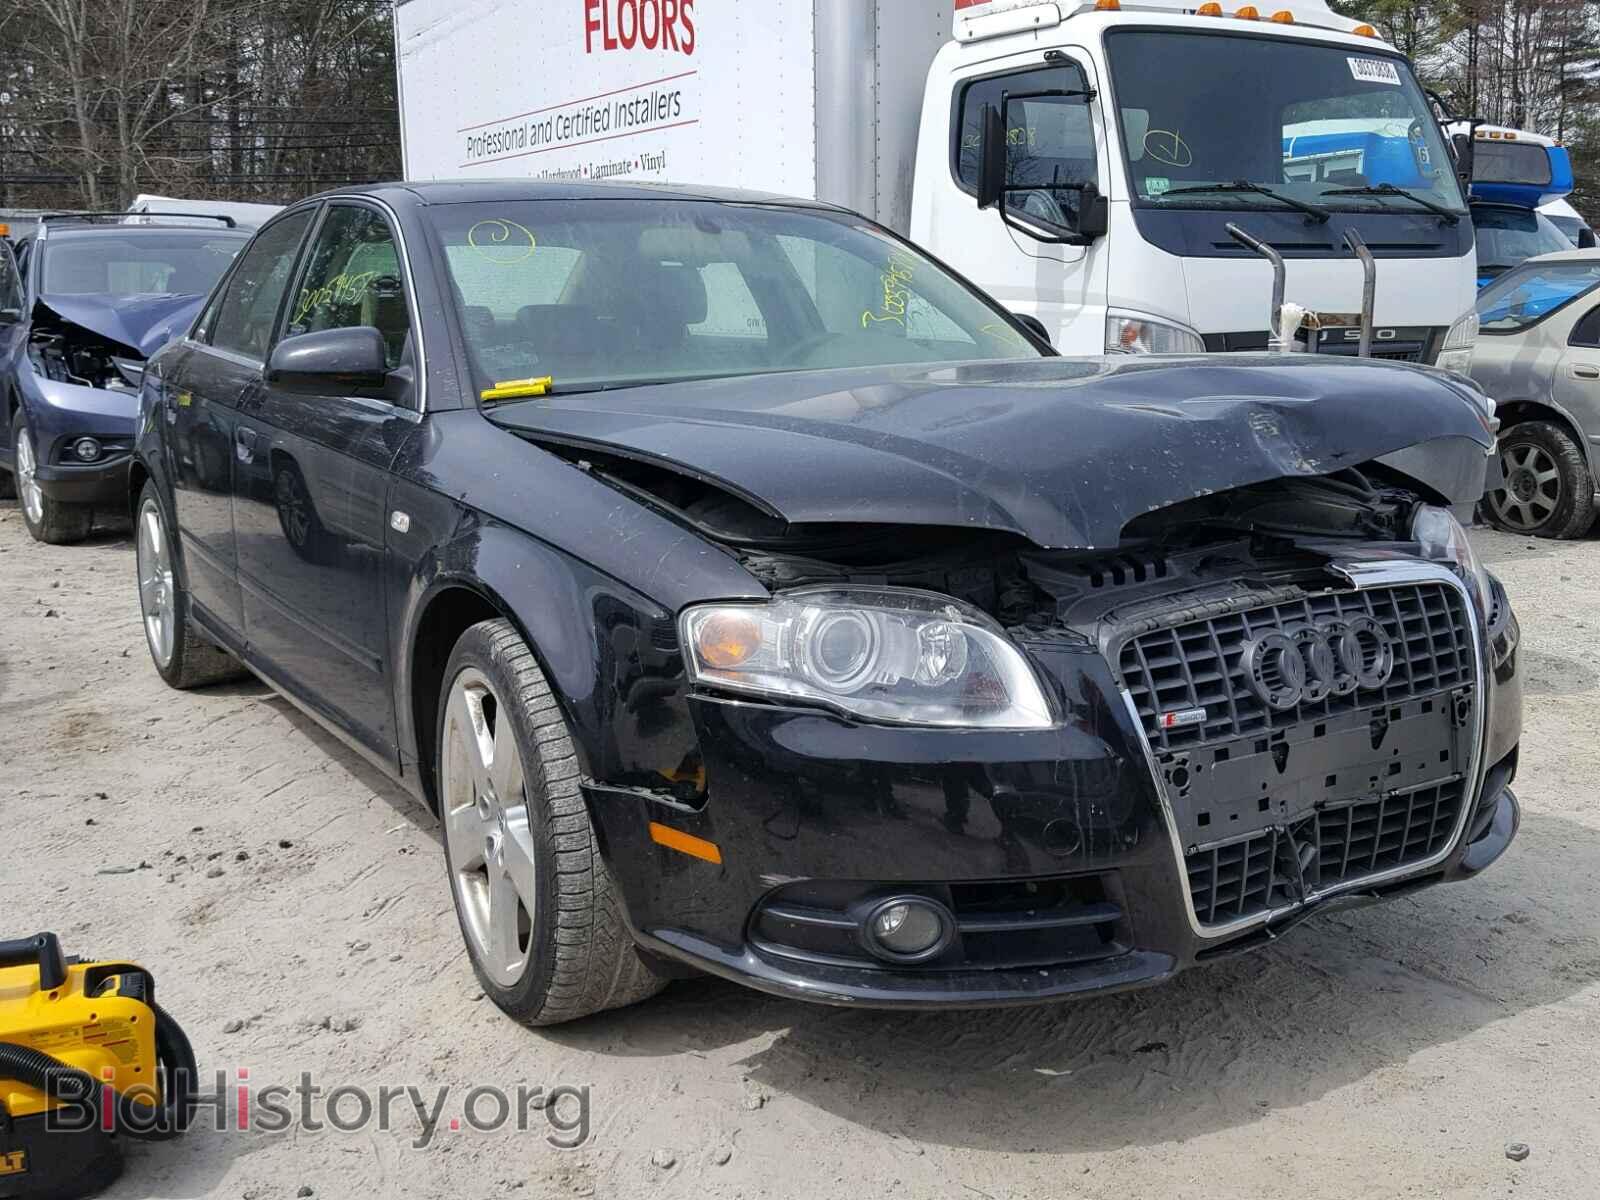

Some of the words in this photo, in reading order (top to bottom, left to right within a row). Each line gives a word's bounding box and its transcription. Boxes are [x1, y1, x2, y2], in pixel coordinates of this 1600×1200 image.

[585, 0, 695, 55] FLOORS
[466, 123, 528, 159] Professional
[530, 117, 553, 144] and
[556, 102, 611, 141] Certified
[614, 90, 681, 129] Installers
[590, 160, 632, 180] Laminate
[640, 150, 666, 174] Vinyl
